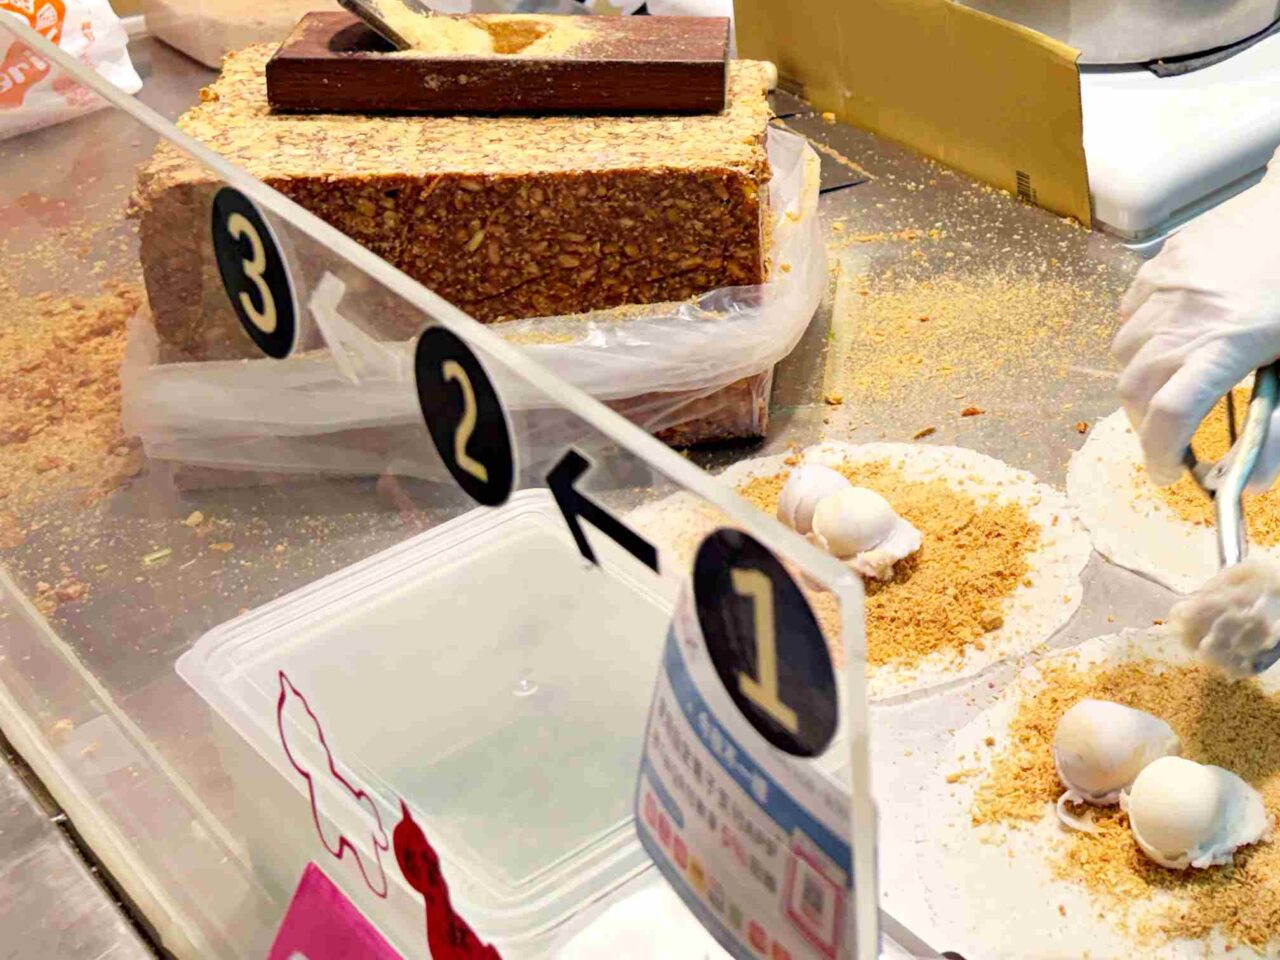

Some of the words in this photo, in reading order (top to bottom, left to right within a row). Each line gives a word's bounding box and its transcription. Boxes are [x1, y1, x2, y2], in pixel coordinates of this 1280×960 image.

[228, 213, 277, 333] 3
[443, 360, 487, 482] 2
[732, 568, 797, 732] 1
